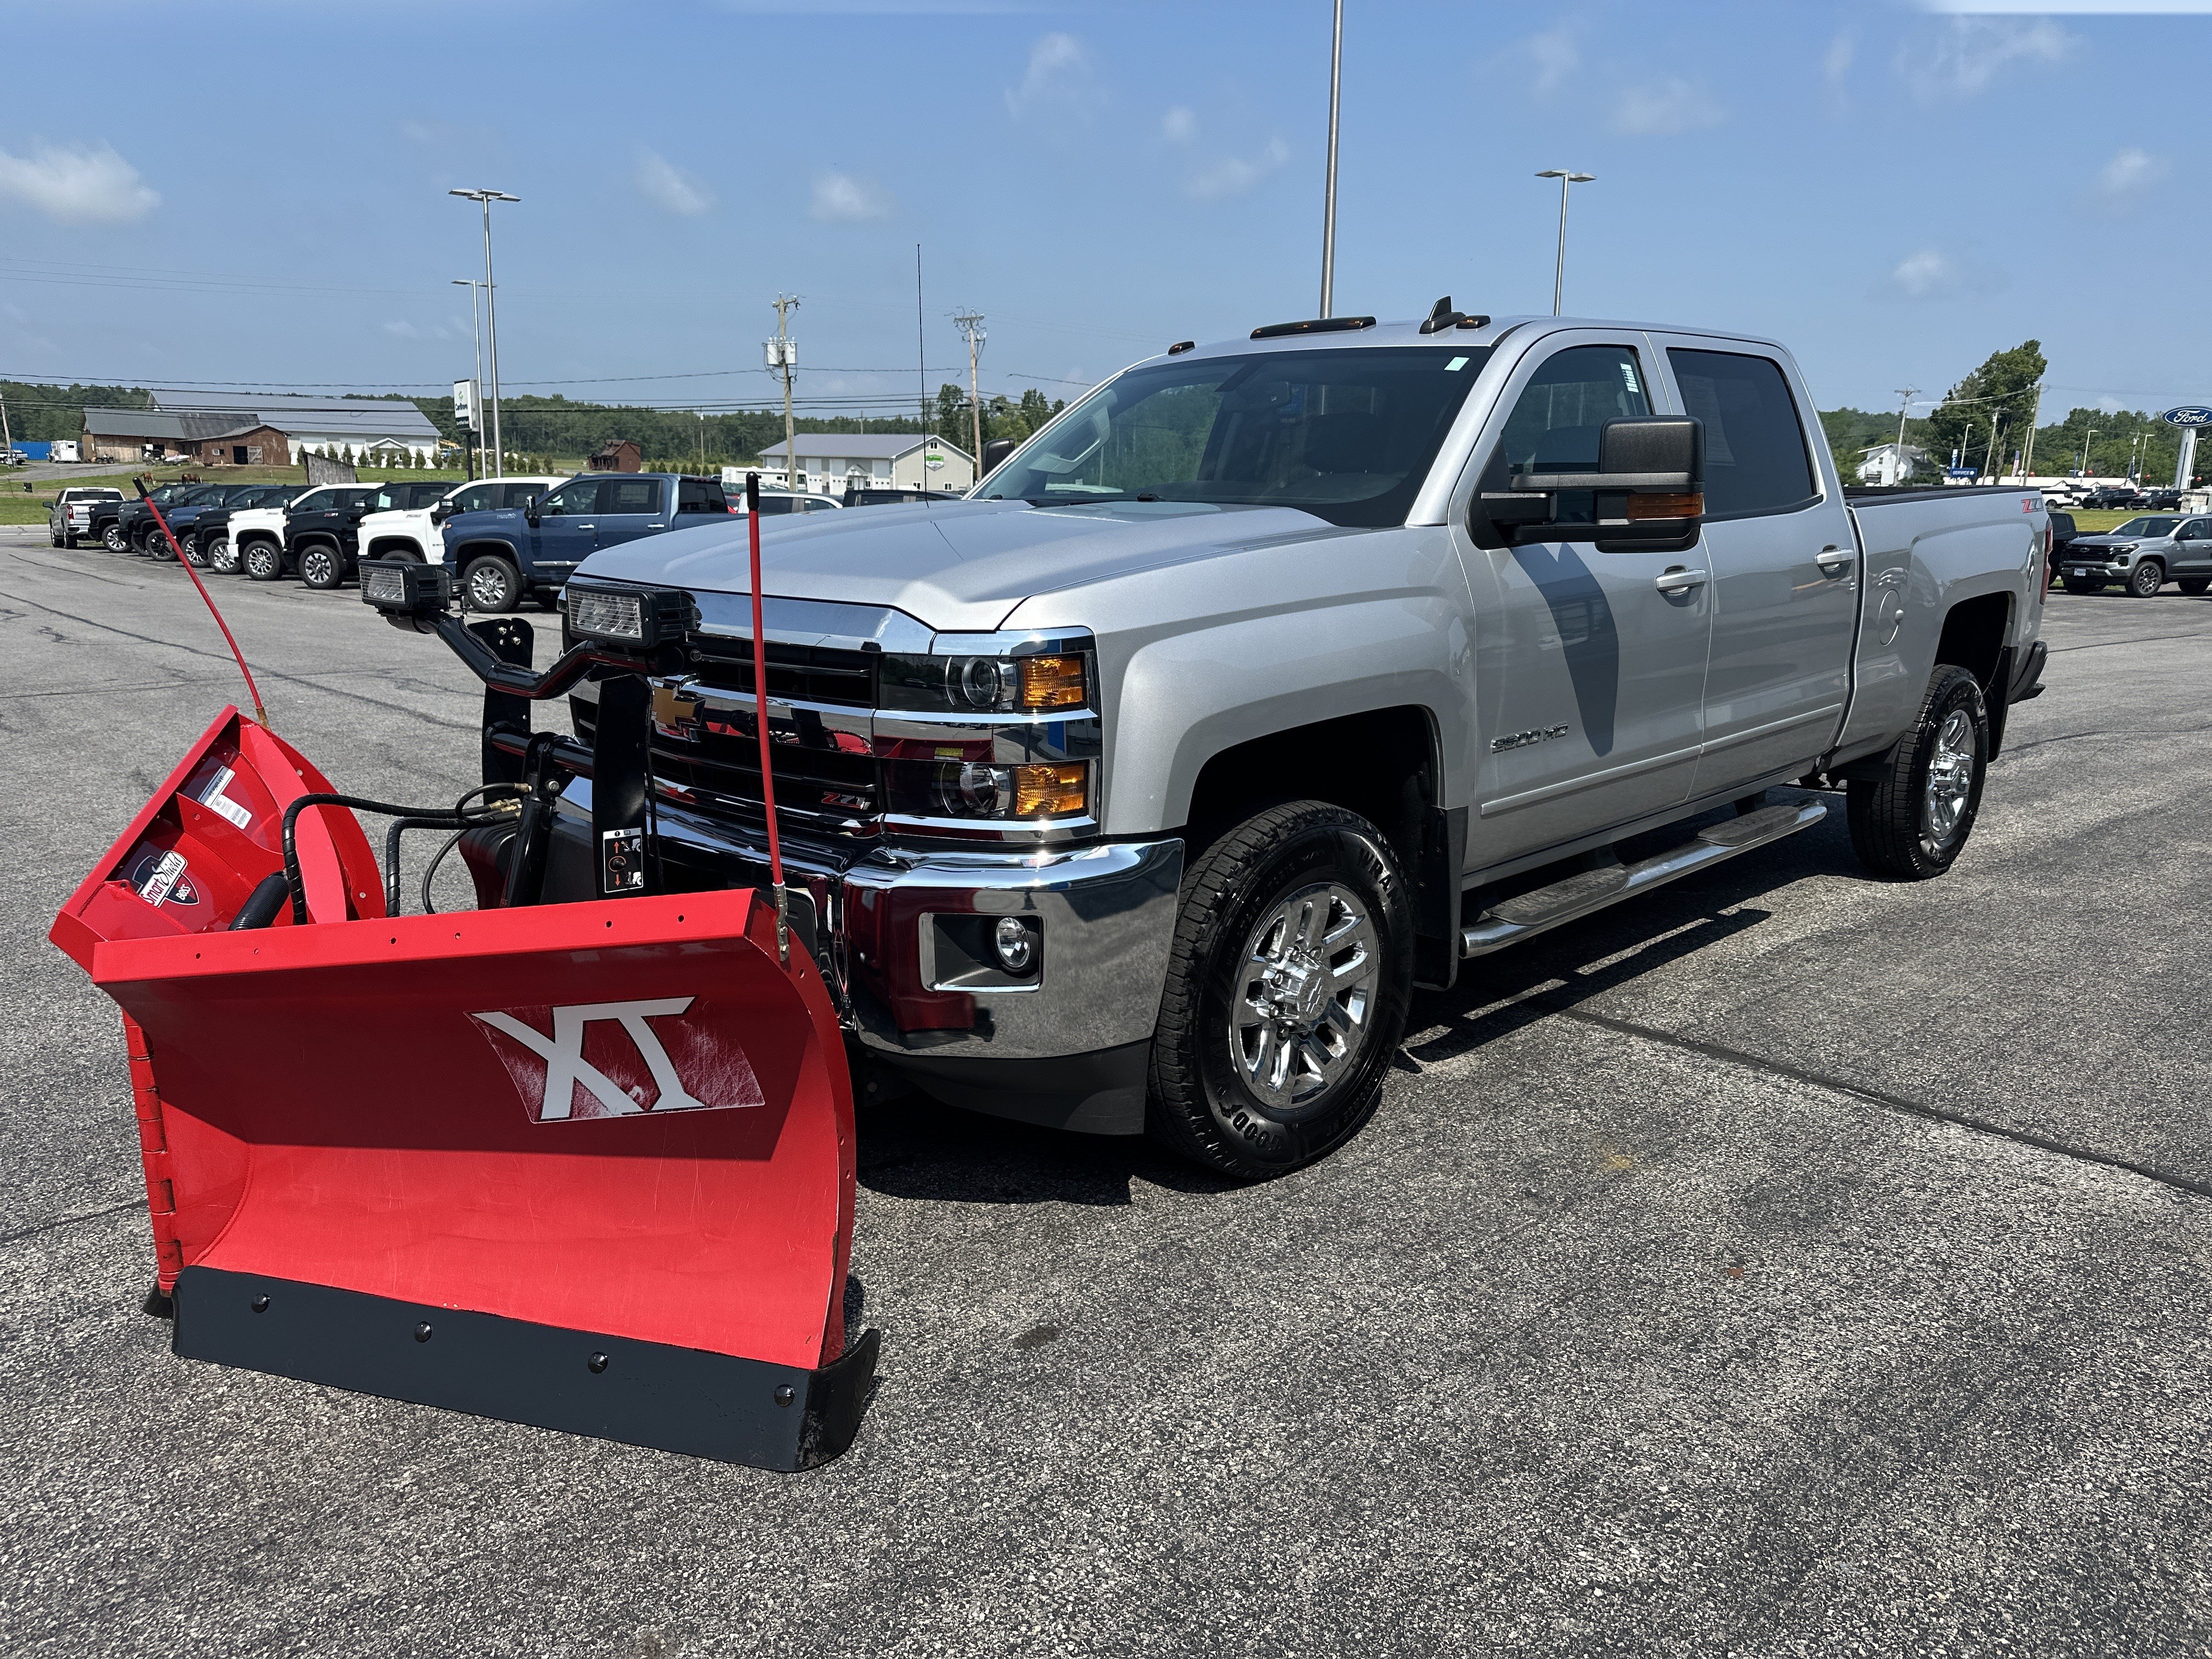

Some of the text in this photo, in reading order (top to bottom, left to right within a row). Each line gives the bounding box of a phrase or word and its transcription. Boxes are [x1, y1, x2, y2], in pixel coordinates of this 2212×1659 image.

[2174, 410, 2209, 423] Ford
[1542, 720, 1568, 741] HD
[821, 791, 871, 810] Z71
[176, 884, 191, 900] BOSS
[471, 995, 707, 1120] XT
